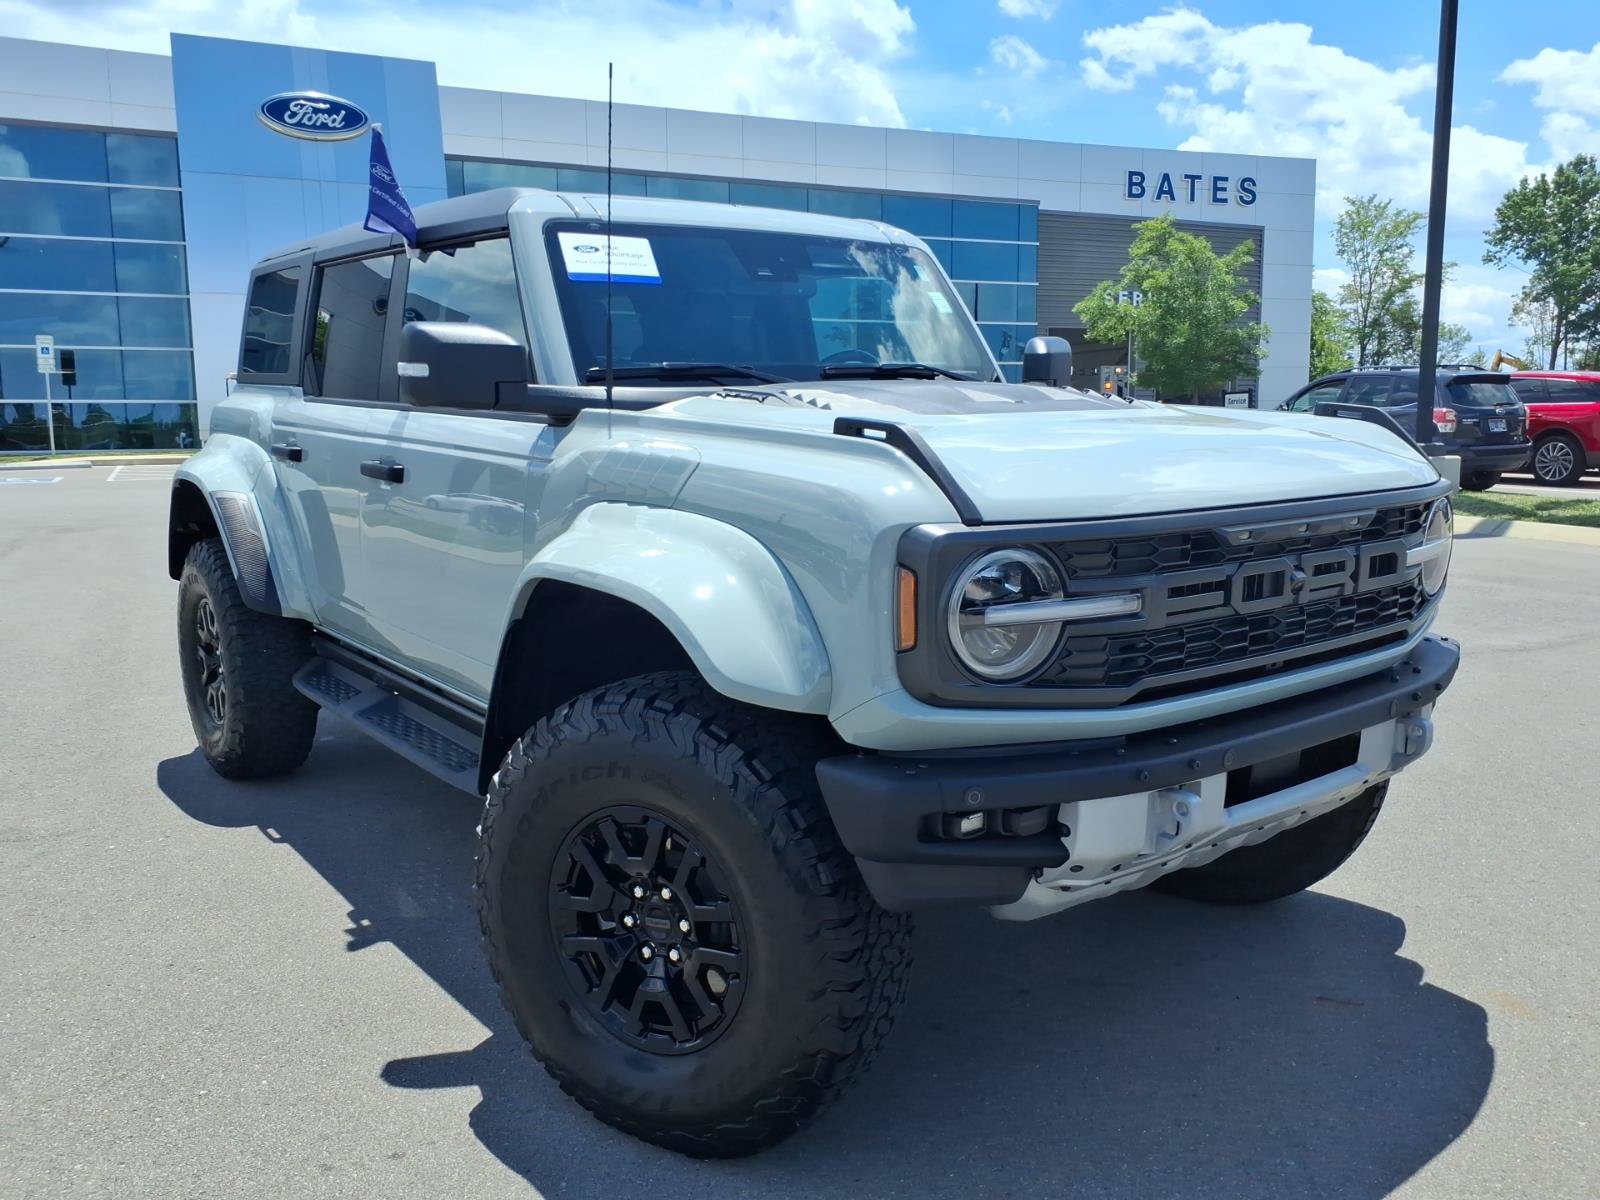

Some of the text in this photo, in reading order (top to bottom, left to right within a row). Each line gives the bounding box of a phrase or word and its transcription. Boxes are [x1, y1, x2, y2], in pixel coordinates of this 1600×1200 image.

[283, 99, 346, 129] Ford
[1126, 170, 1257, 206] BATES
[1156, 539, 1410, 629] FORD
